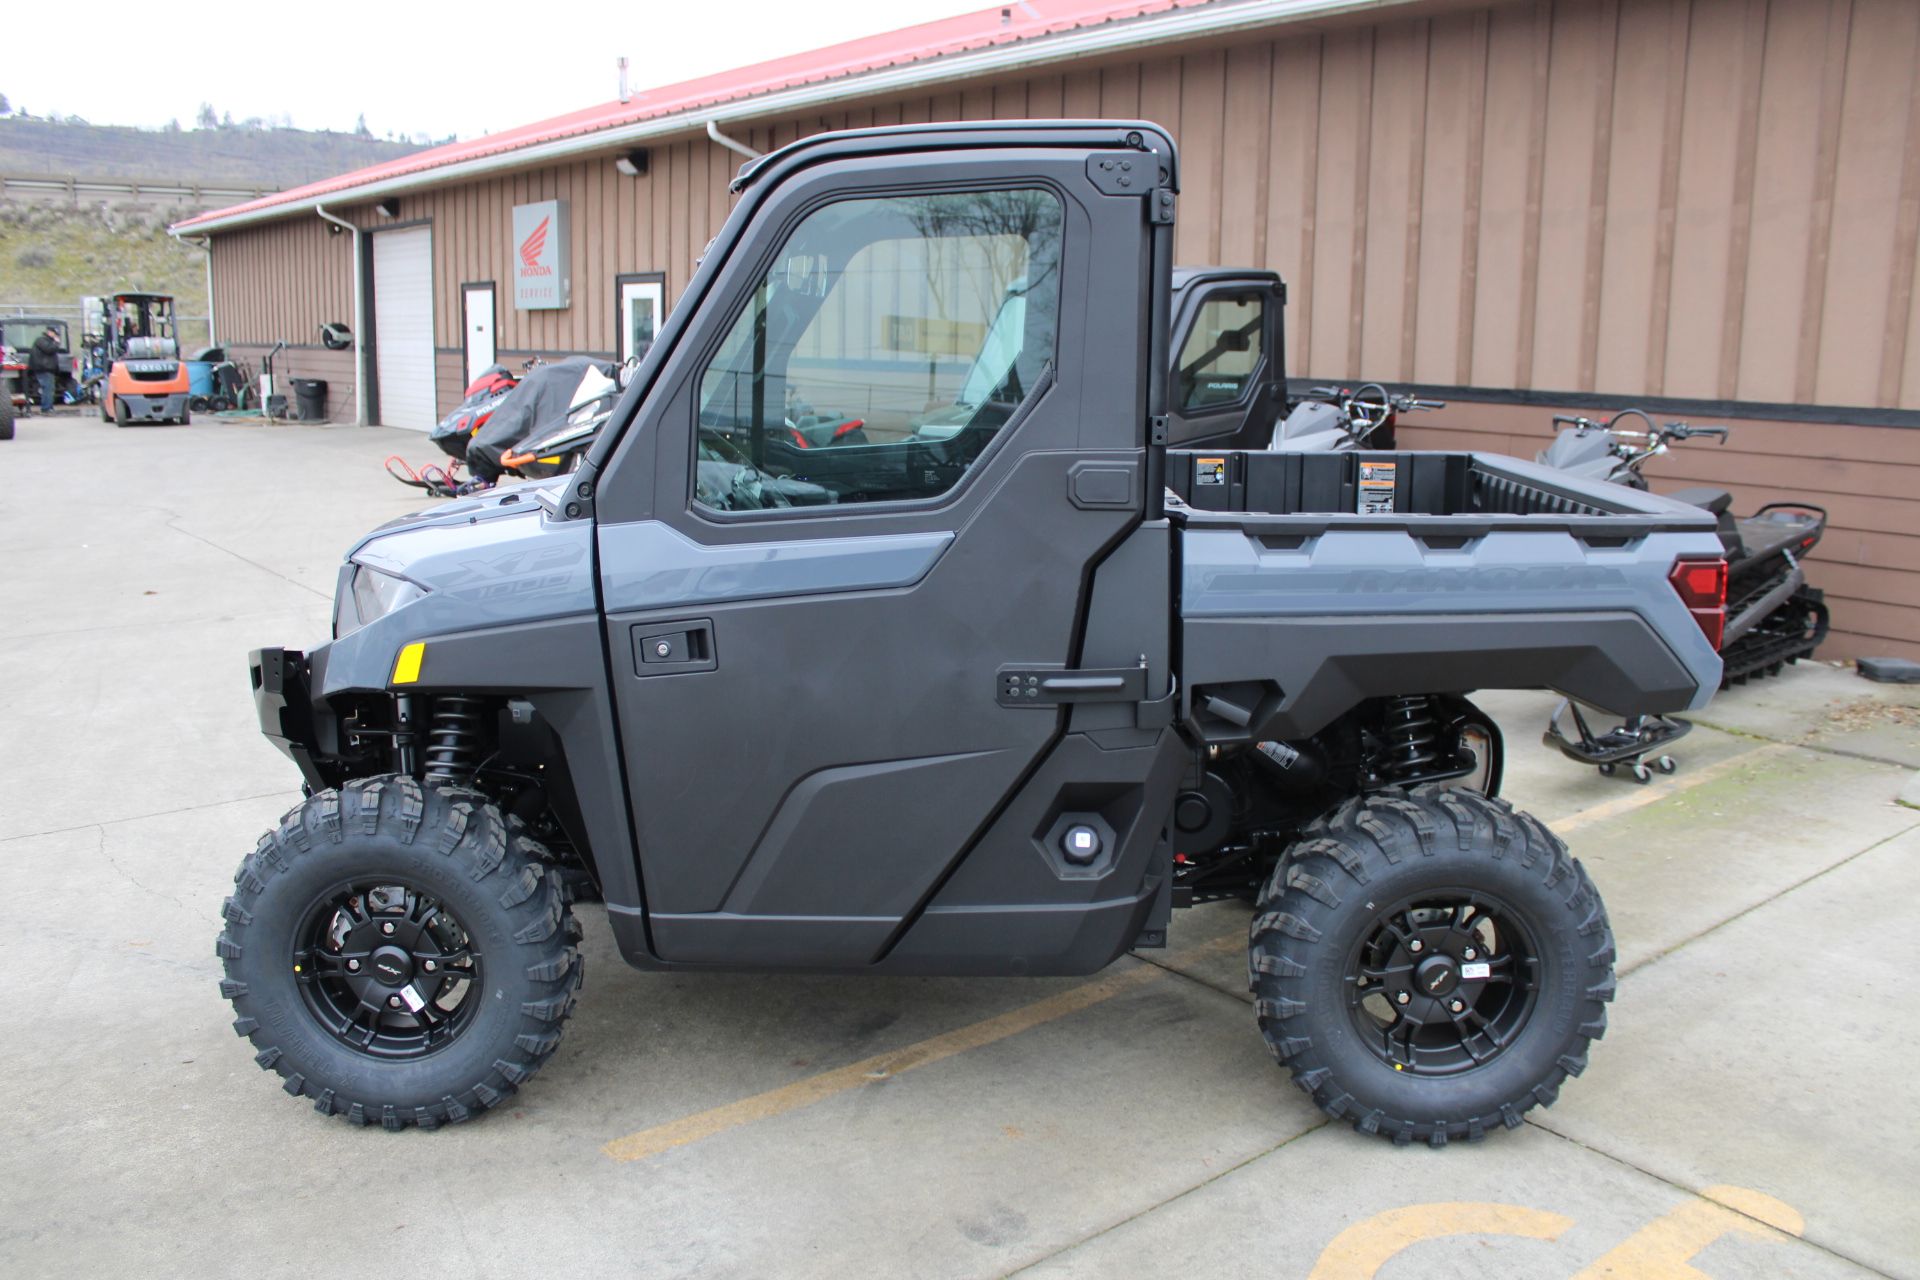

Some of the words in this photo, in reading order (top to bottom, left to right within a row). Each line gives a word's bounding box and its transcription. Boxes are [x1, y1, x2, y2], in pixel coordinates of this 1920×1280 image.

[520, 265, 552, 278] HONDA
[134, 362, 174, 372] TOYOTA
[447, 542, 584, 586] XP
[478, 571, 574, 599] 1000
